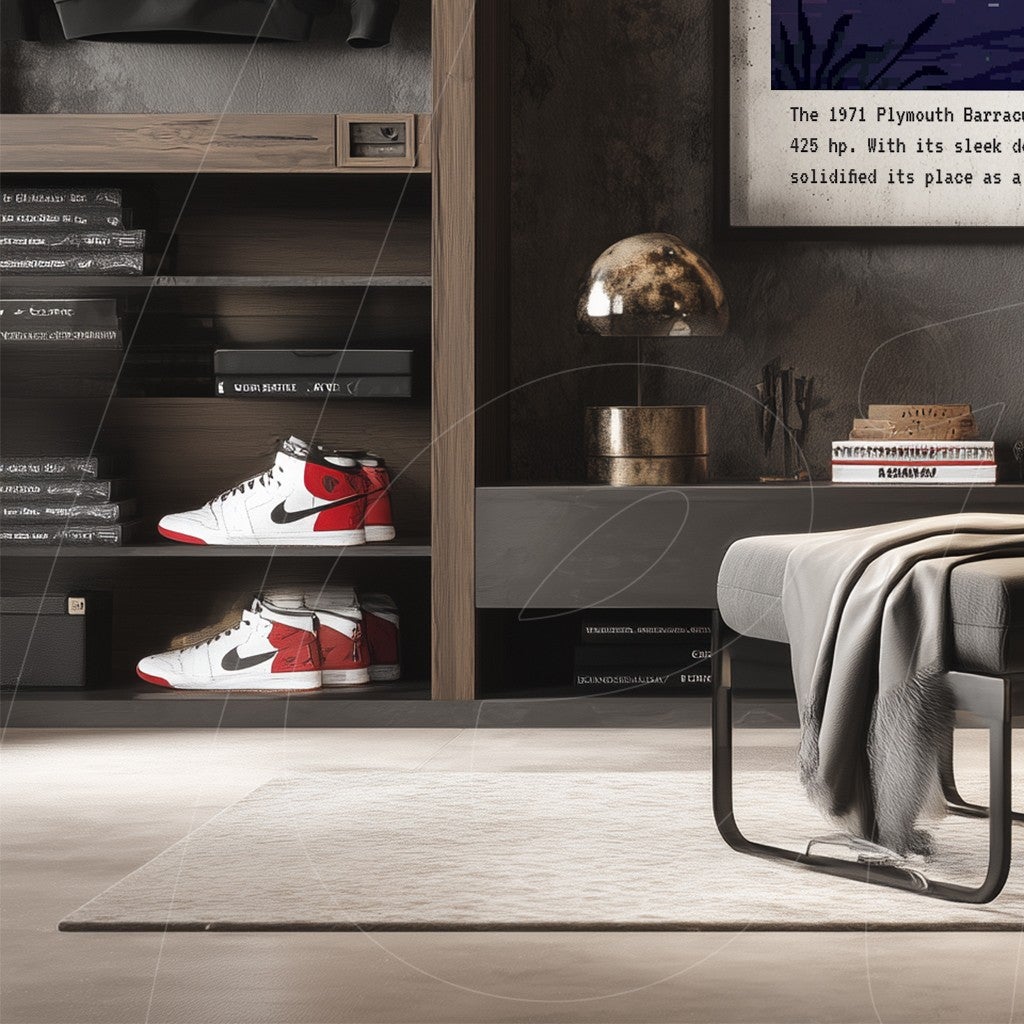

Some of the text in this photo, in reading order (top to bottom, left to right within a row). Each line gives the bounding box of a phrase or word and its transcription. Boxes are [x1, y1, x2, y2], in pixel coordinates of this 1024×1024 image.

[789, 106, 819, 122] The
[829, 106, 866, 122] 1971
[877, 106, 954, 126] Plymouth
[789, 137, 819, 153] 425
[828, 137, 856, 157] hp.
[867, 137, 906, 153] With
[916, 137, 944, 153] its
[954, 138, 1002, 154] sleek
[790, 168, 877, 184] solidified
[887, 168, 915, 184] its
[925, 168, 973, 188] place
[983, 172, 1002, 185] as
[1012, 173, 1022, 185] a
